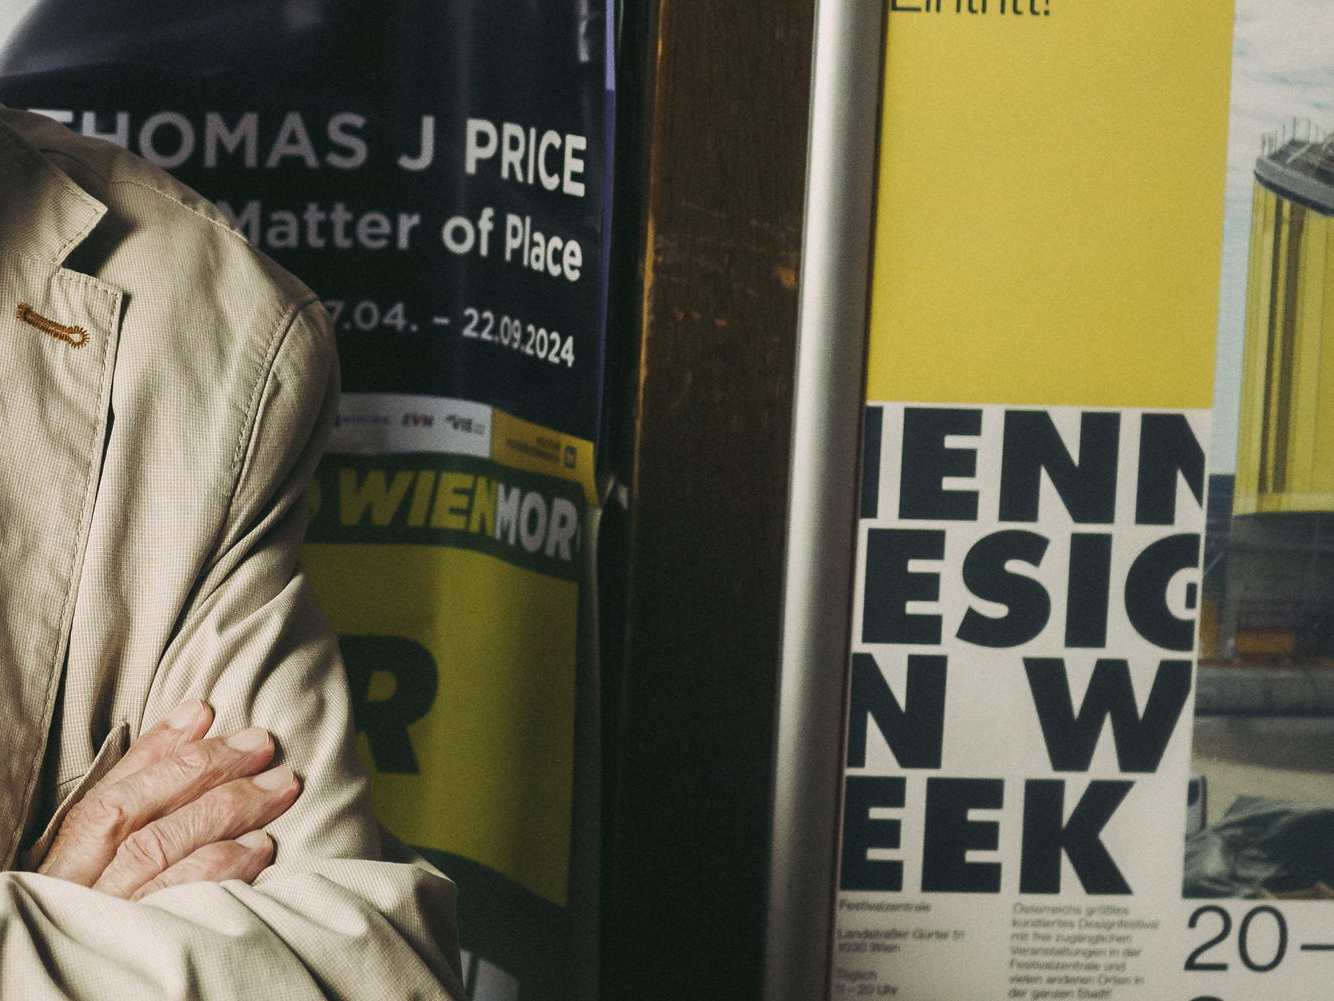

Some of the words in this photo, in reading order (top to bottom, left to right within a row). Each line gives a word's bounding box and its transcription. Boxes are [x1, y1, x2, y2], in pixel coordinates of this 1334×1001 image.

[398, 115, 436, 172] J
[465, 117, 587, 198] PRICE
[441, 208, 494, 257] of
[504, 214, 583, 282] Place
[462, 308, 575, 368] 22.09.2024
[1023, 656, 1193, 773] W
[840, 775, 1137, 896] EEK
